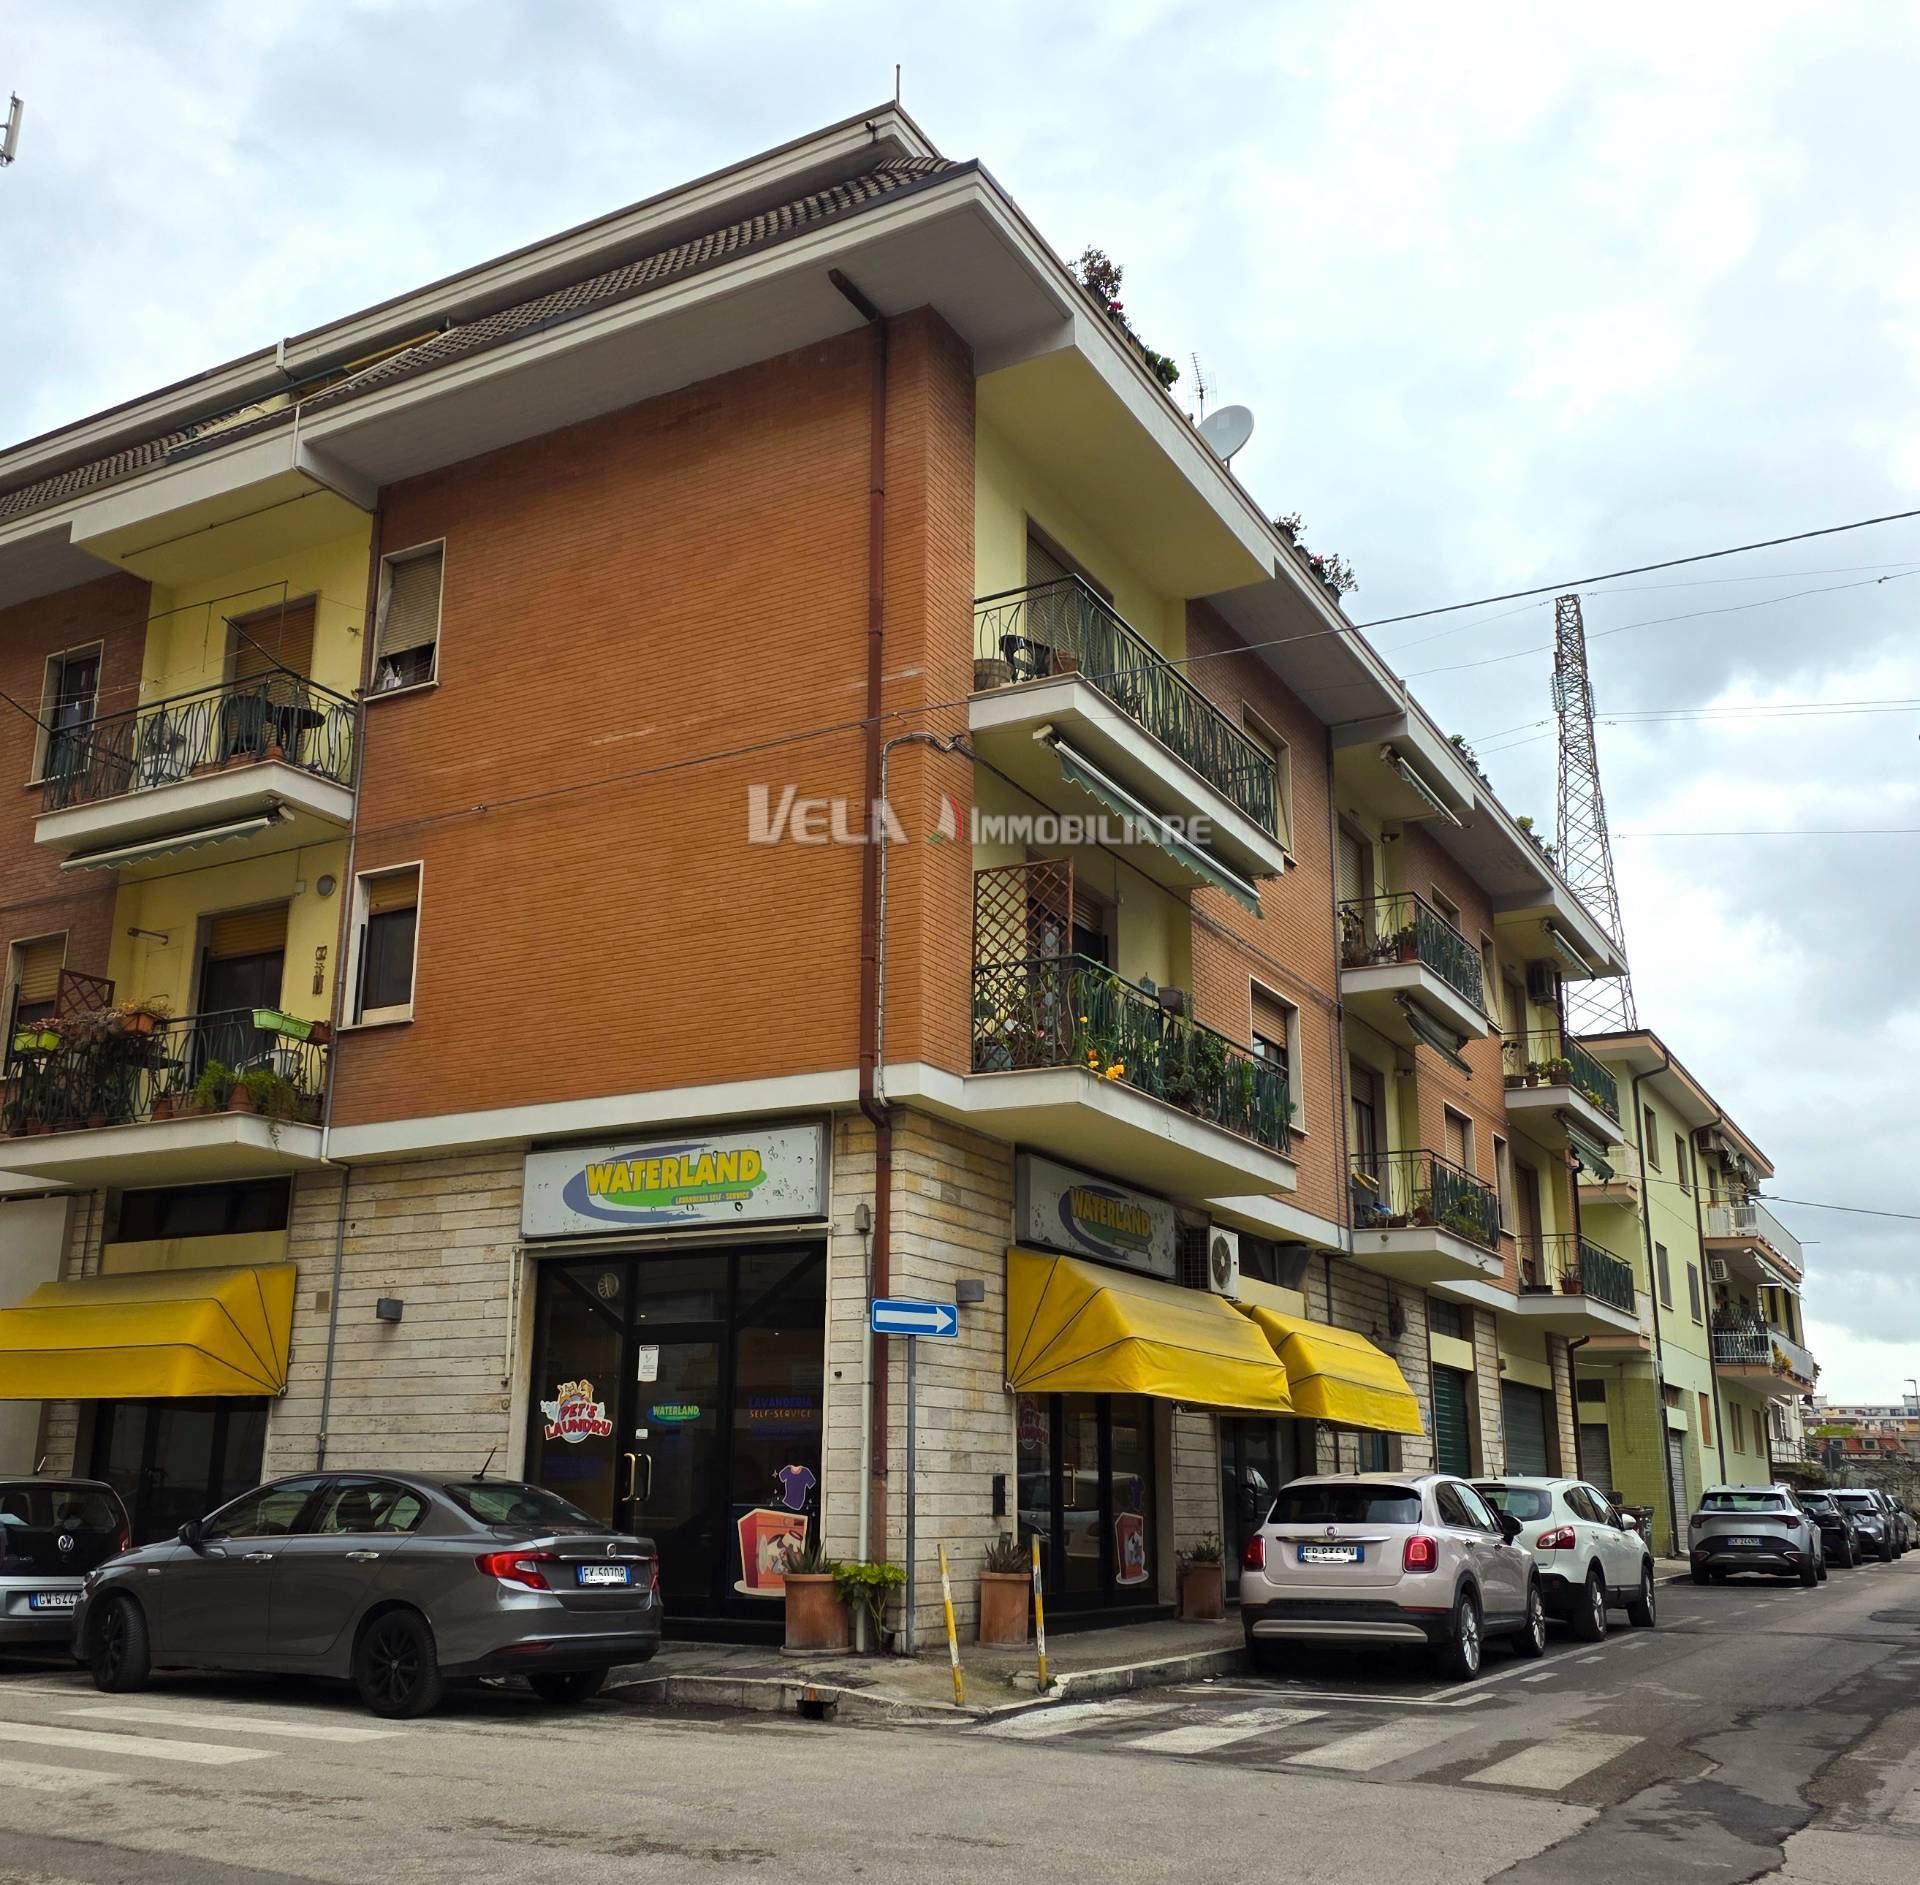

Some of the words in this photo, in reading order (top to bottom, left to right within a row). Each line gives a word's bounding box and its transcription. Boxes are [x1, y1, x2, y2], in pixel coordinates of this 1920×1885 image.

[586, 1149, 762, 1196] WATERLAND
[1070, 1187, 1152, 1238] WATERLAND
[560, 1403, 597, 1420] PET'S
[652, 1405, 701, 1416] WATERLAND
[545, 1419, 611, 1439] LAUNDRY
